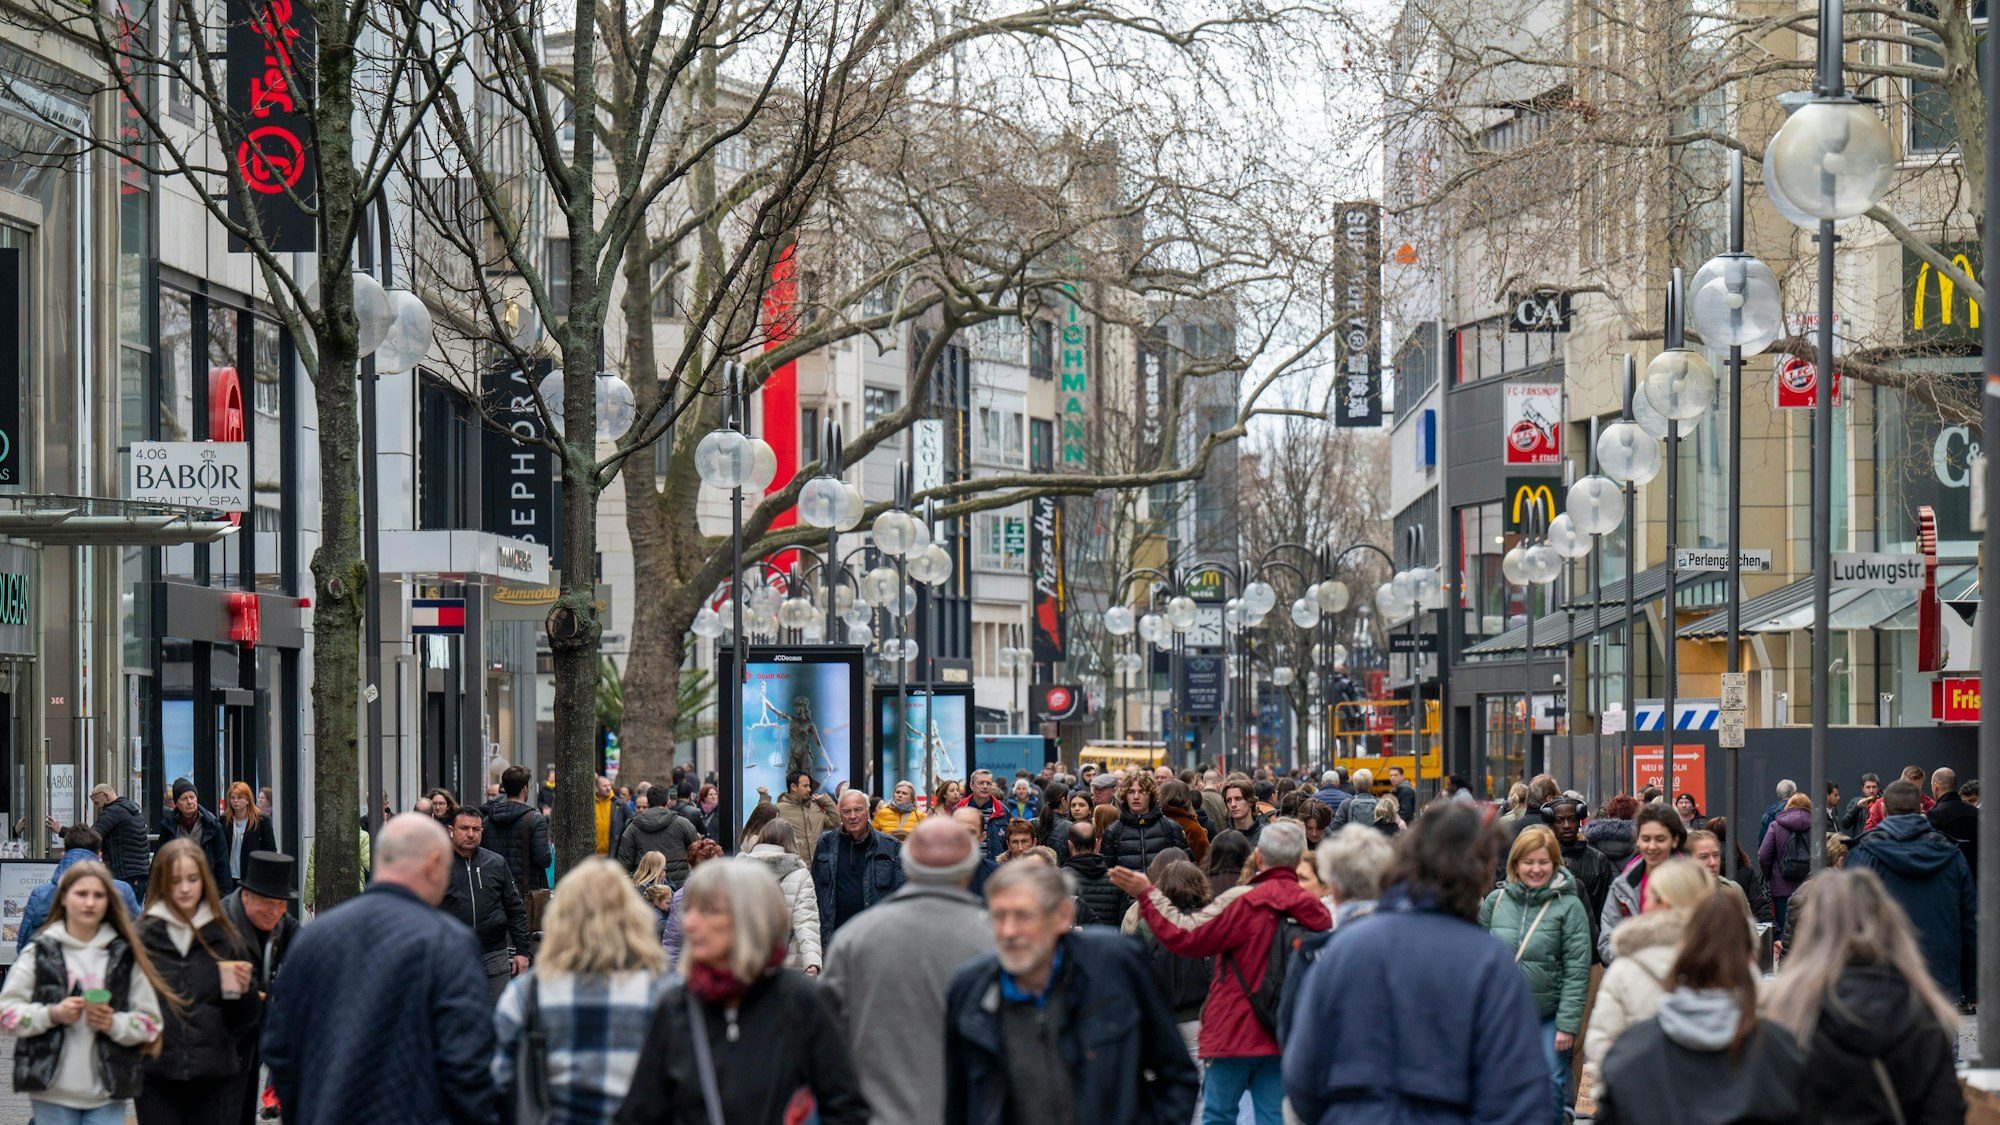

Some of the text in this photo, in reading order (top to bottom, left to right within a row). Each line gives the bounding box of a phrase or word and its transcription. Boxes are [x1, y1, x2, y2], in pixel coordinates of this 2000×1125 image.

[1517, 300, 1563, 325] C&A
[1062, 256, 1085, 464] ICHMANN
[511, 367, 536, 544] EPHORA
[136, 464, 241, 490] BABOR
[209, 497, 241, 505] SPA
[1689, 553, 1761, 568] Perlengächen
[1833, 559, 1924, 584] Ludwigstr.
[757, 671, 792, 680] Stadt Köln
[1641, 763, 1656, 771] NEU
[1673, 762, 1687, 772] ÖLN
[50, 774, 73, 789] ABOR
